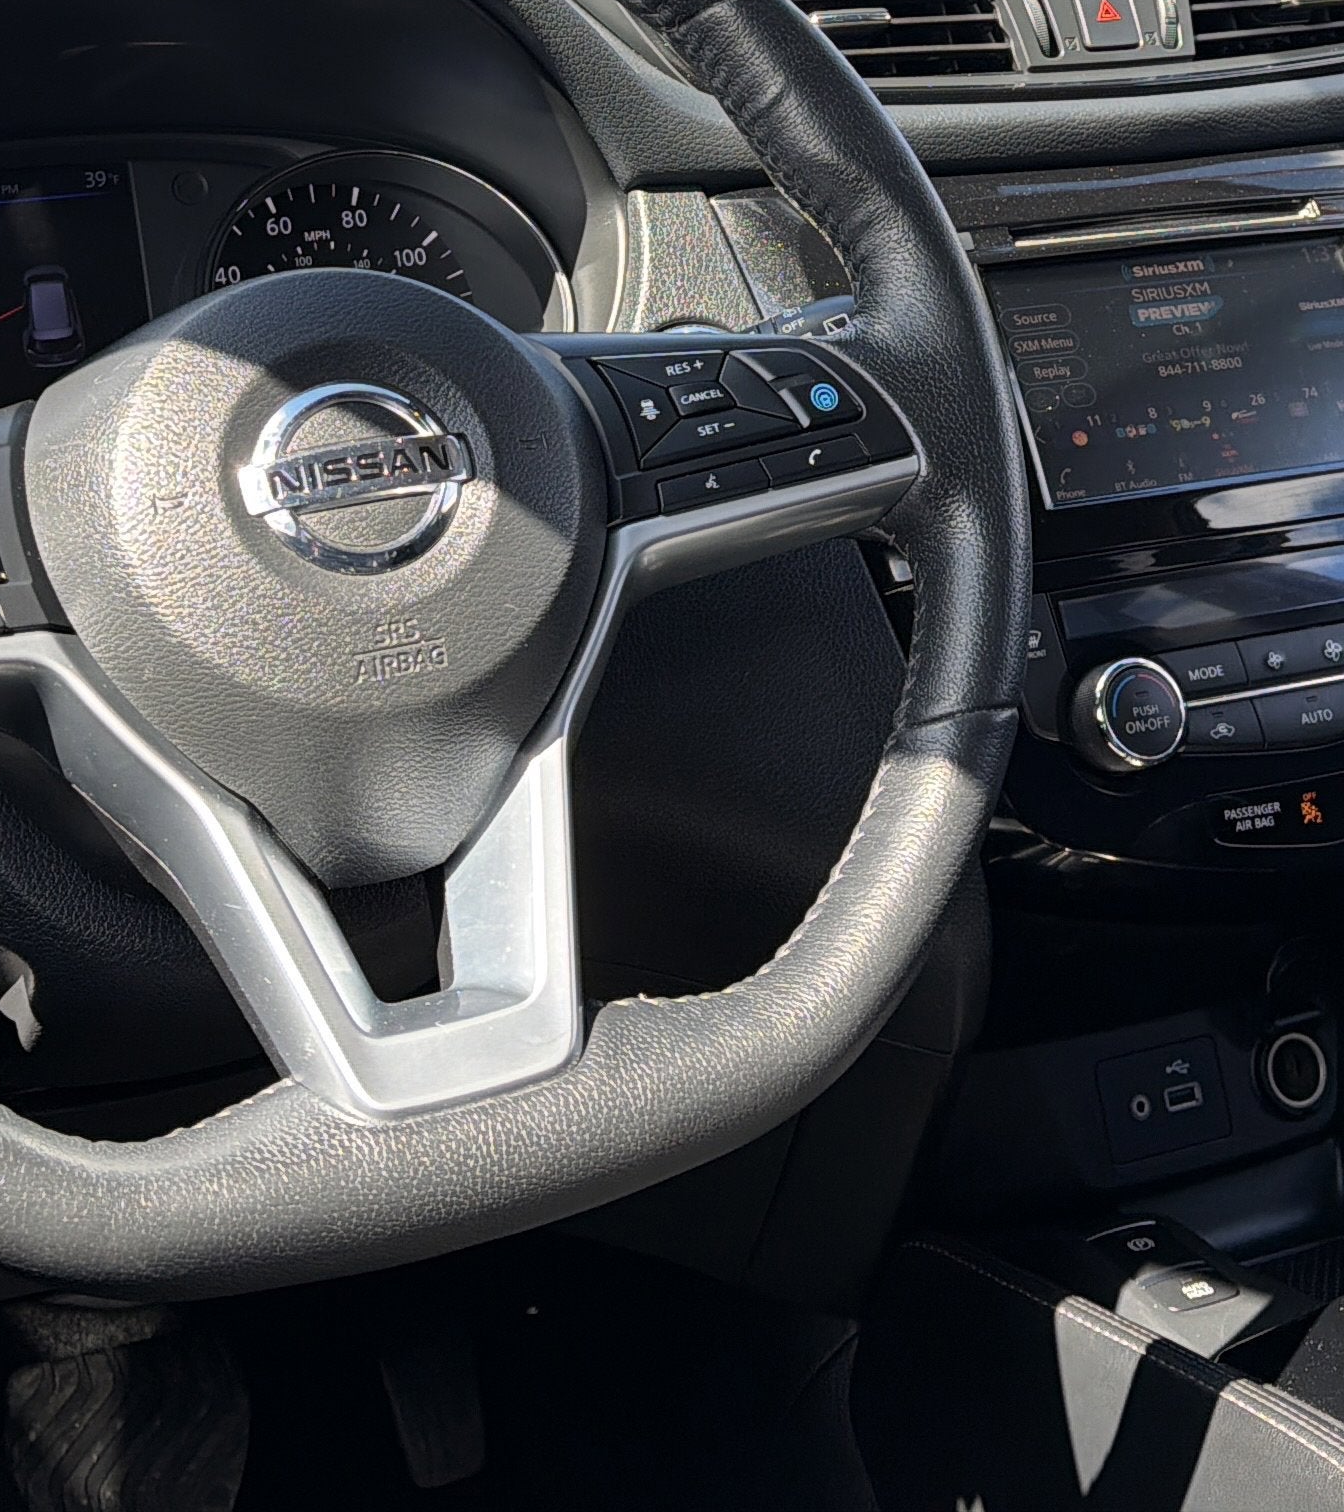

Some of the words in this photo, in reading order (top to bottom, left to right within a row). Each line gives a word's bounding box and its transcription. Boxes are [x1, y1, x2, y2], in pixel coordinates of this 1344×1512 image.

[267, 217, 292, 237] 60
[341, 209, 367, 228] 80
[304, 229, 331, 242] MPH
[294, 255, 313, 268] 100
[393, 247, 426, 268] 100
[214, 265, 241, 286] 40
[1131, 282, 1211, 303] SIRIUSXM
[1013, 310, 1058, 326] Source
[1137, 301, 1216, 322] PREVIEW
[781, 316, 806, 334] OFF
[1195, 322, 1203, 333] 1
[1014, 341, 1039, 354] SXM
[1040, 336, 1074, 351] Menu
[665, 361, 692, 378] RES
[1033, 362, 1071, 381] Replay
[1157, 356, 1243, 378] 844-711-8800
[680, 388, 725, 406] CANCEL
[1249, 393, 1266, 406] 26
[1302, 387, 1318, 399] 74
[1147, 407, 1158, 419] 8
[1202, 400, 1212, 412] 9
[1086, 414, 1103, 427] 11
[697, 422, 721, 438] SET
[268, 443, 454, 502] NISSAN
[1129, 478, 1157, 490] Audio
[1056, 489, 1086, 501] Phone
[356, 645, 448, 684] AIRBAG
[1188, 664, 1225, 681] MODE
[1132, 704, 1160, 718] PUSH
[1301, 709, 1333, 726] AUTO
[1302, 791, 1317, 802] OFF
[1223, 801, 1281, 820] PASSENGER
[1235, 821, 1254, 833] AIR
[1254, 816, 1275, 829] BAG
